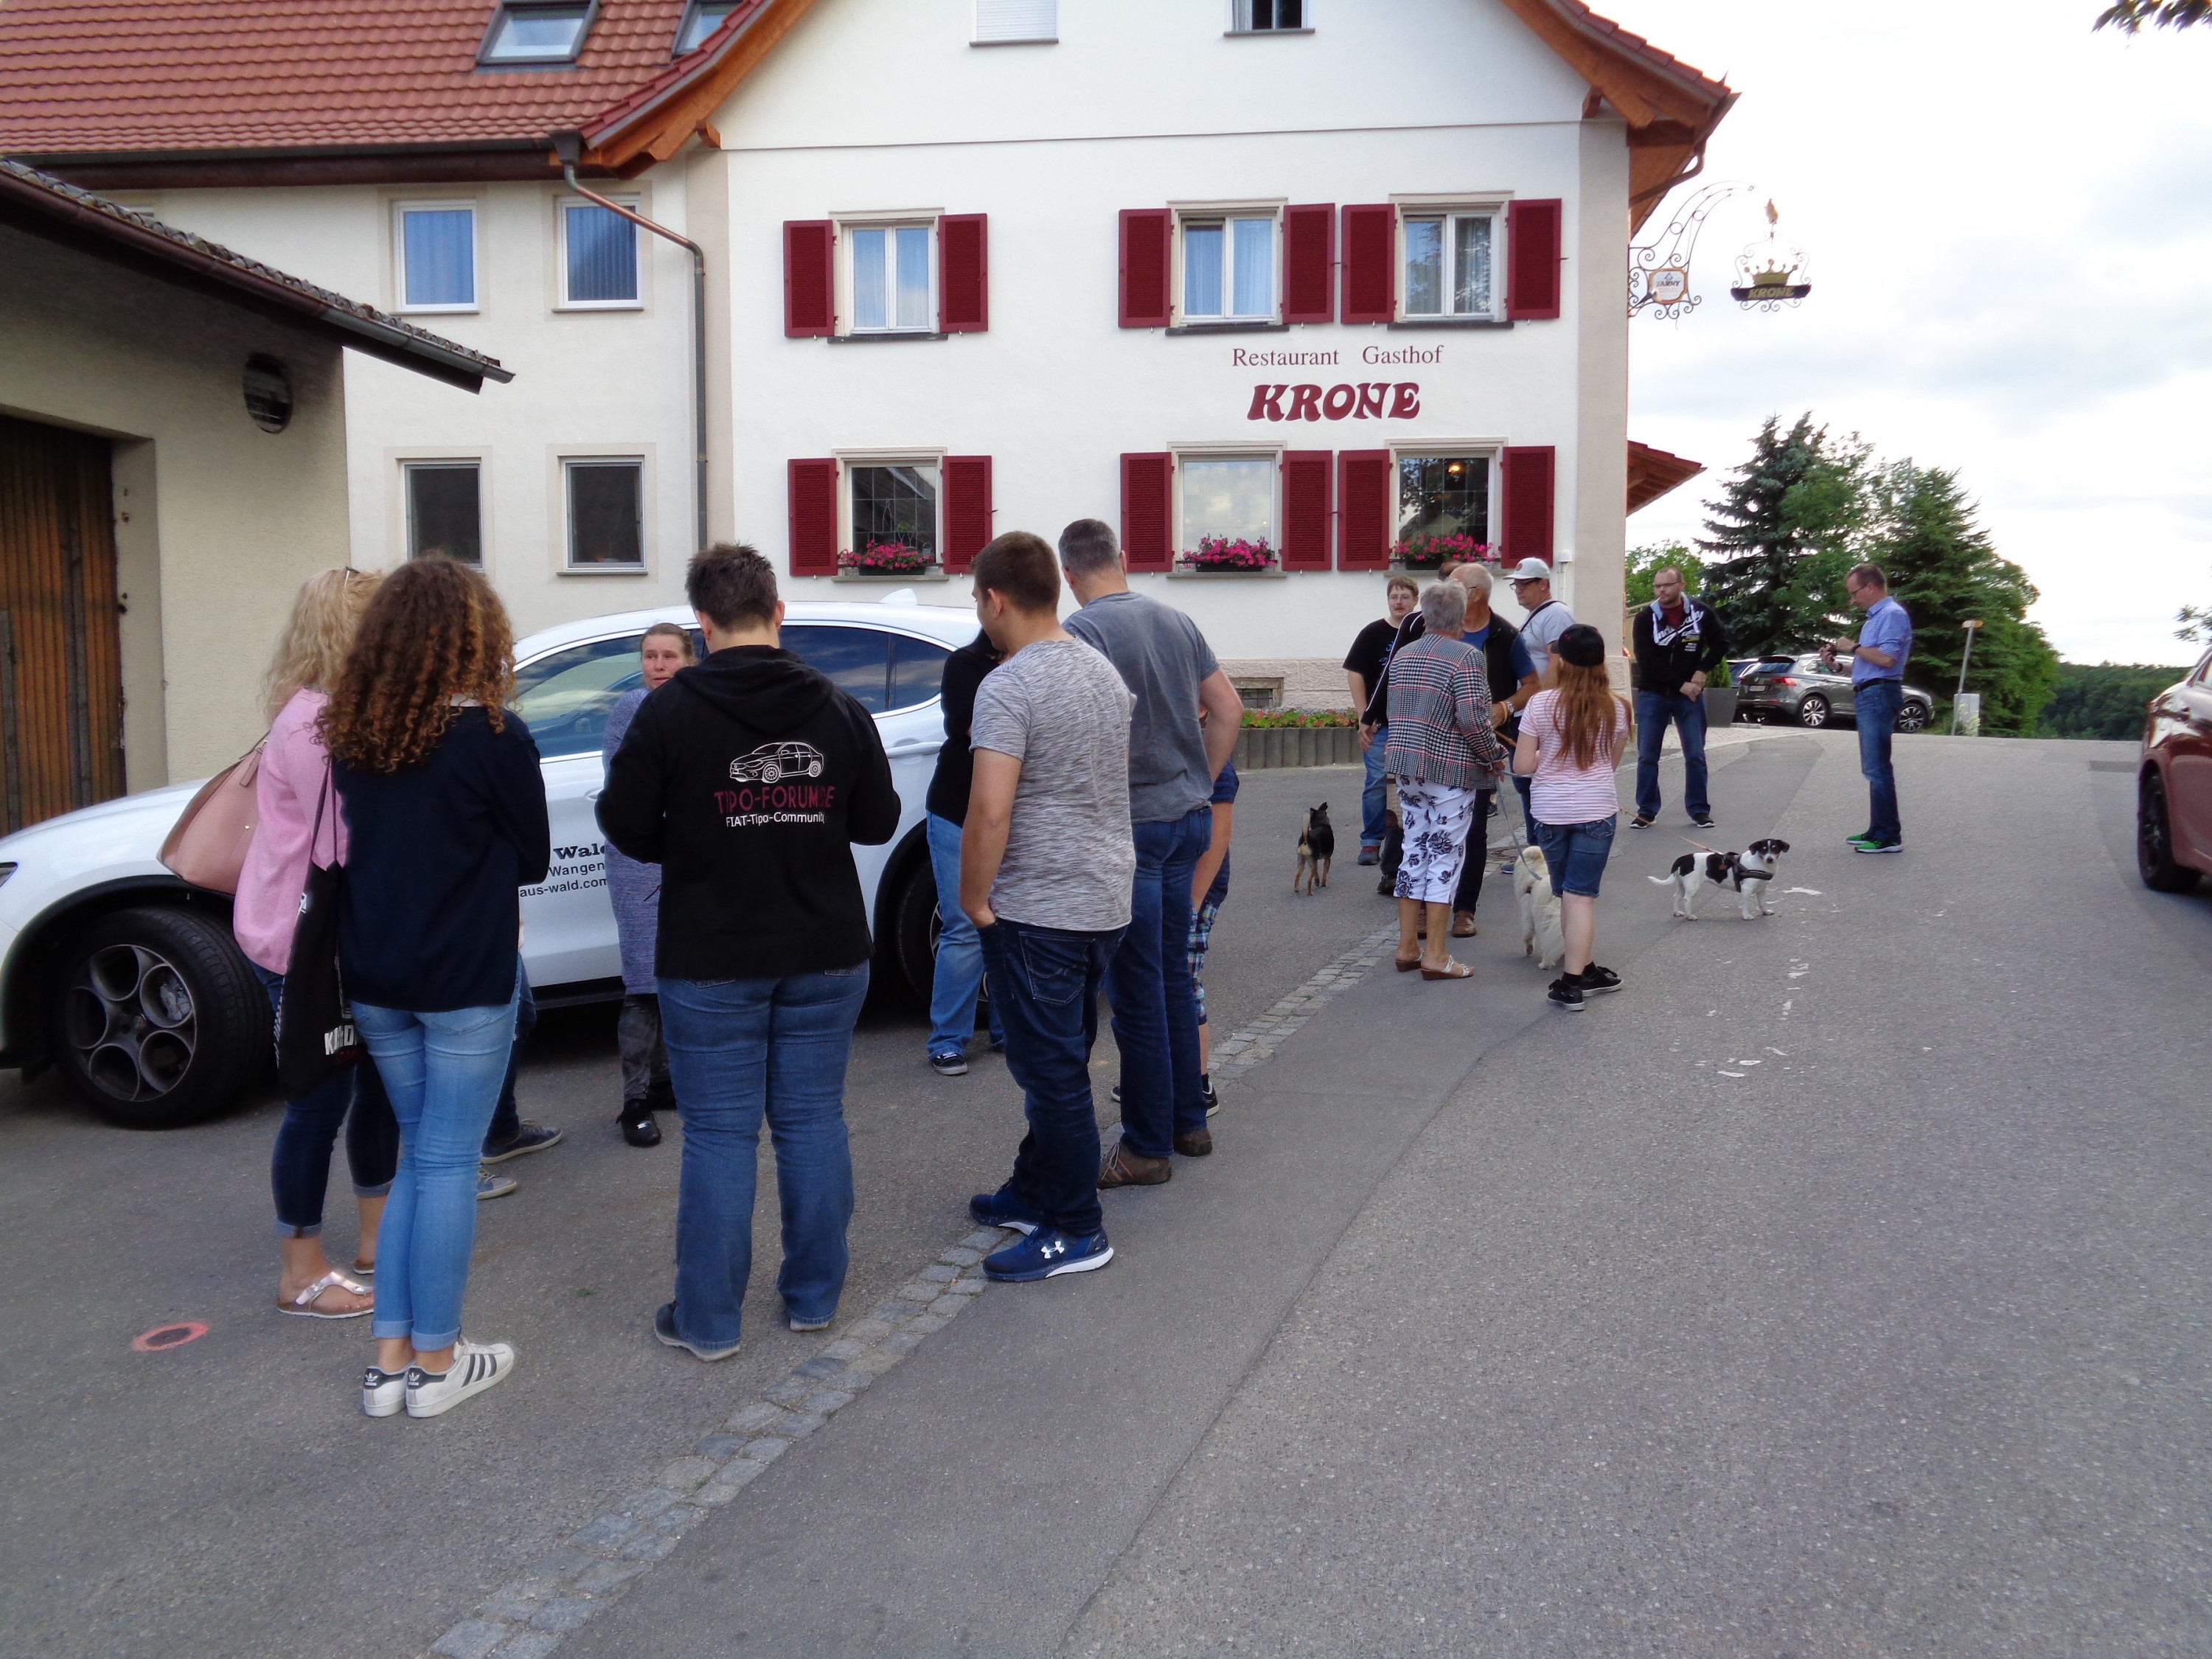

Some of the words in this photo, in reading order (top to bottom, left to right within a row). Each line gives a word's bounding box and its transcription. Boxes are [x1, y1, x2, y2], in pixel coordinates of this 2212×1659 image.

[1747, 287, 1795, 299] KRONE
[1231, 348, 1340, 366] Restaurant
[1362, 344, 1444, 364] Gasthof
[1247, 382, 1420, 422] KRONE
[549, 862, 605, 877] Wangen
